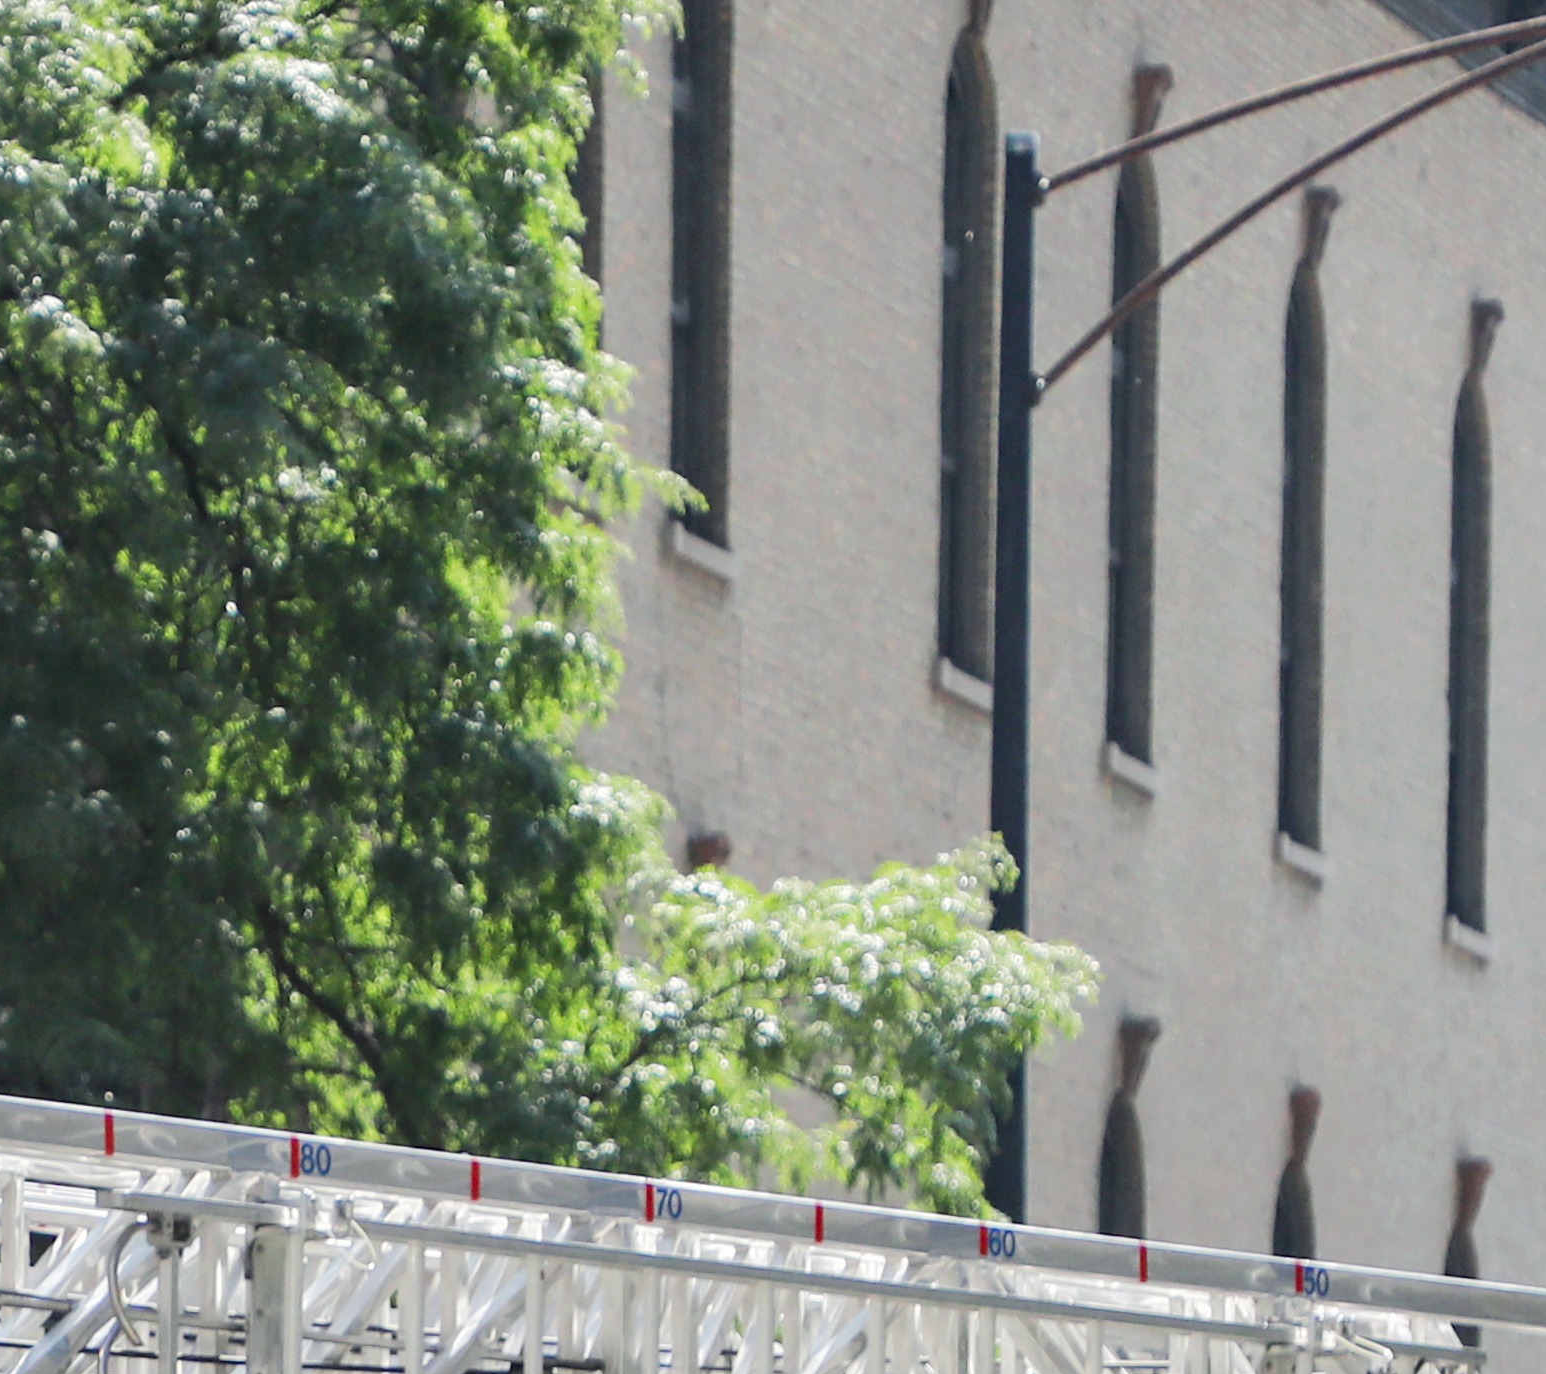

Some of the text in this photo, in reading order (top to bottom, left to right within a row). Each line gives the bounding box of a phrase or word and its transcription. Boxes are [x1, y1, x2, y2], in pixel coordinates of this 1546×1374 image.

[301, 1142, 331, 1175] 80
[657, 1187, 682, 1219] 70
[989, 1228, 1016, 1257] 60
[1304, 1267, 1329, 1296] 50
